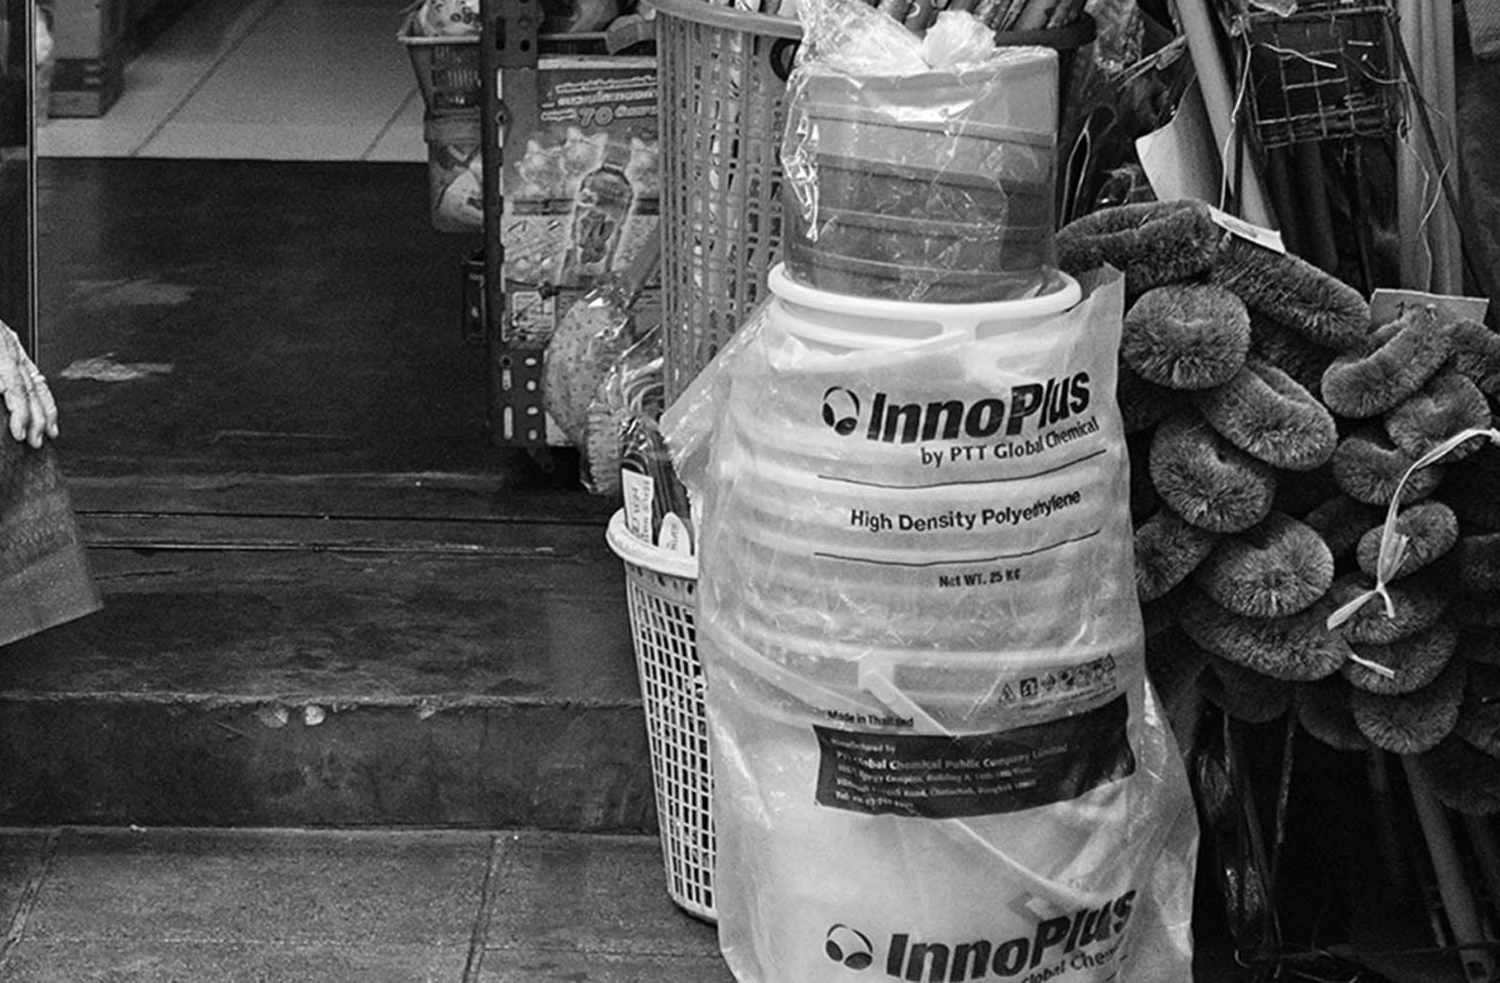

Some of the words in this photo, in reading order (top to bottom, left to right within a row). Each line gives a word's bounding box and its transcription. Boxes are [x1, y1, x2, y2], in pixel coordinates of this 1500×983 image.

[866, 371, 1091, 444] InnoPlus
[920, 447, 944, 467] by
[950, 444, 988, 461] PTT
[994, 439, 1043, 460] Global
[1045, 416, 1100, 448] Chemical
[851, 508, 893, 532] High
[899, 510, 976, 531] Density
[990, 570, 1003, 584] 25
[886, 889, 1137, 983] InnoPlus
